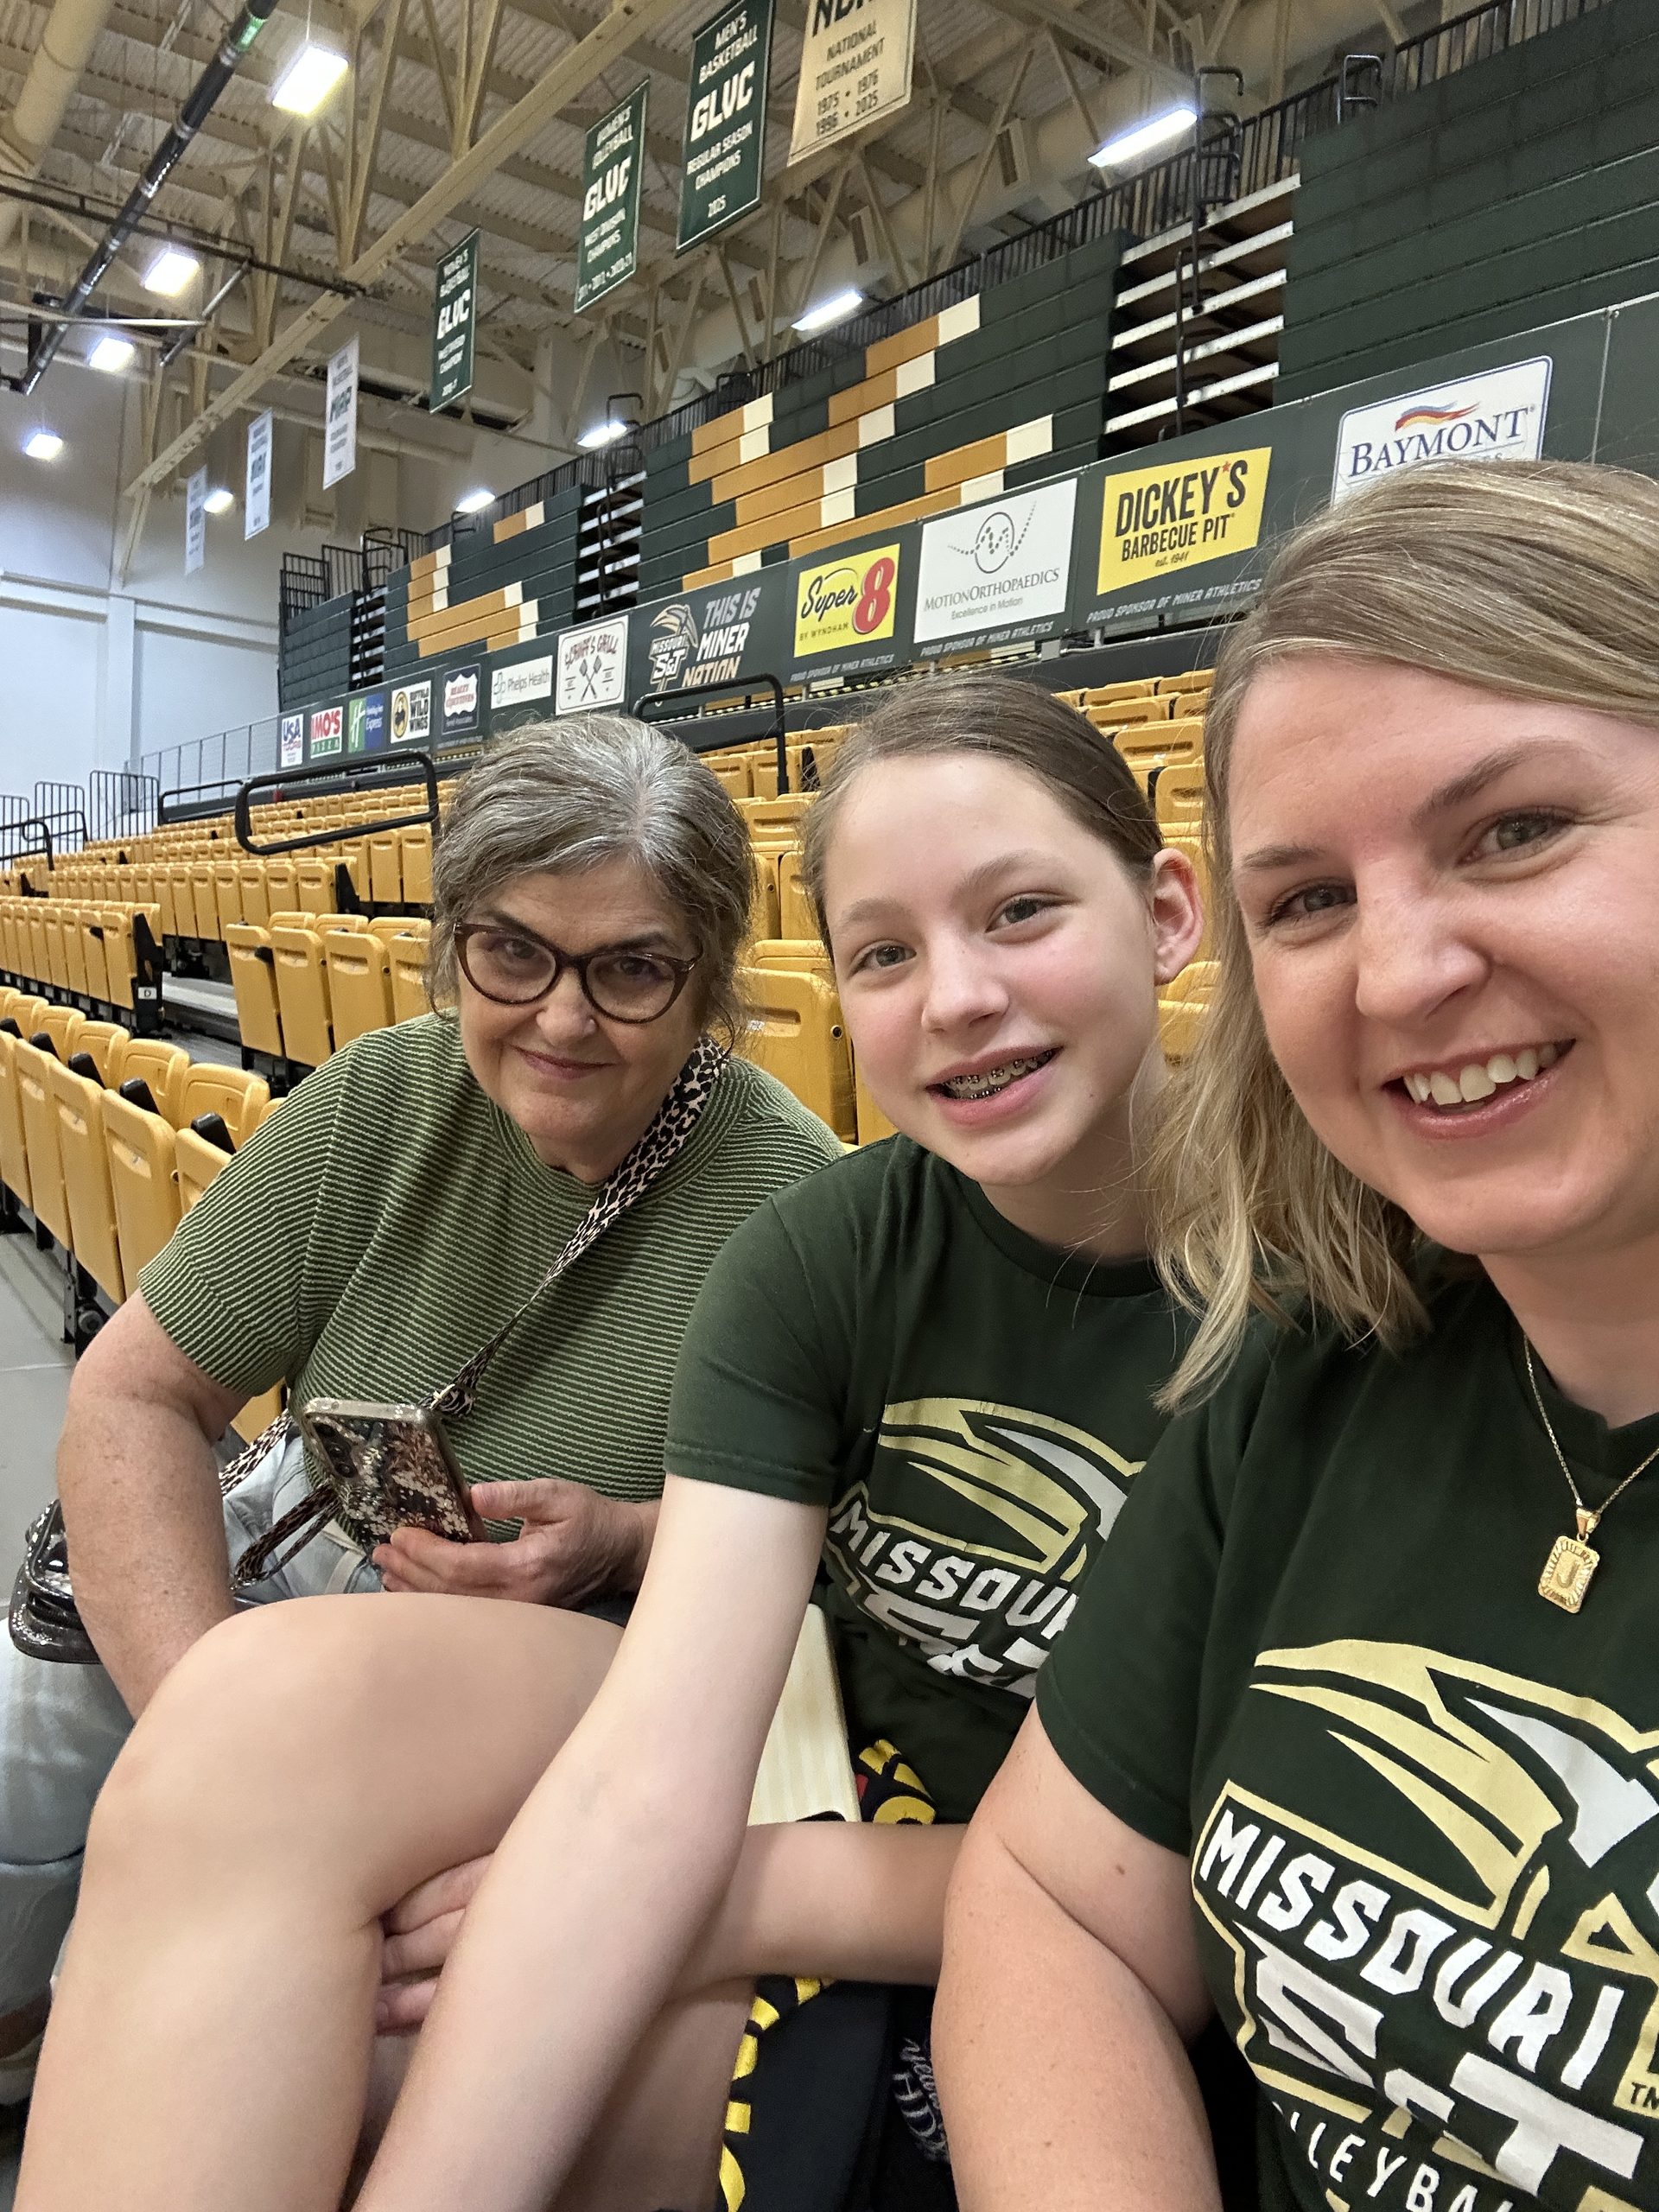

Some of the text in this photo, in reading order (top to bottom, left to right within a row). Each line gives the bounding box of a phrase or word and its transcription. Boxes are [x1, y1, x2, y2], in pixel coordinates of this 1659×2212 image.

[715, 10, 747, 50] MEN'S
[827, 19, 877, 61] NATIONAL
[699, 24, 757, 84] BASKETBALL
[816, 36, 885, 91] TOURNAMENT
[696, 149, 741, 190] CHAMPIONS
[1348, 406, 1529, 477] BAYMONT
[1116, 459, 1249, 537] DICKEY'S
[1122, 514, 1230, 562] BARBECUE PIT
[1171, 551, 1190, 564] 1941
[703, 588, 761, 630] THIS IS
[801, 557, 895, 635] Super 8
[951, 596, 1023, 620] Excellence in Motion
[1087, 578, 1262, 623] PROUD SPONSOR OF MINER ATHLETICS
[652, 635, 684, 652] MISSOURI
[696, 621, 750, 662] MINER
[799, 623, 849, 641] BY WYNDHAM
[943, 637, 976, 652] SPONSOR
[976, 635, 987, 646] OF
[987, 630, 1011, 644] MINER
[1011, 621, 1054, 639] ATHLETICS
[508, 675, 527, 693] Phelps
[529, 669, 550, 687] Health
[652, 648, 686, 679] S&T
[682, 656, 741, 688] NATION
[410, 698, 429, 718] WILD
[1199, 1809, 1624, 2089] MISSOURI
